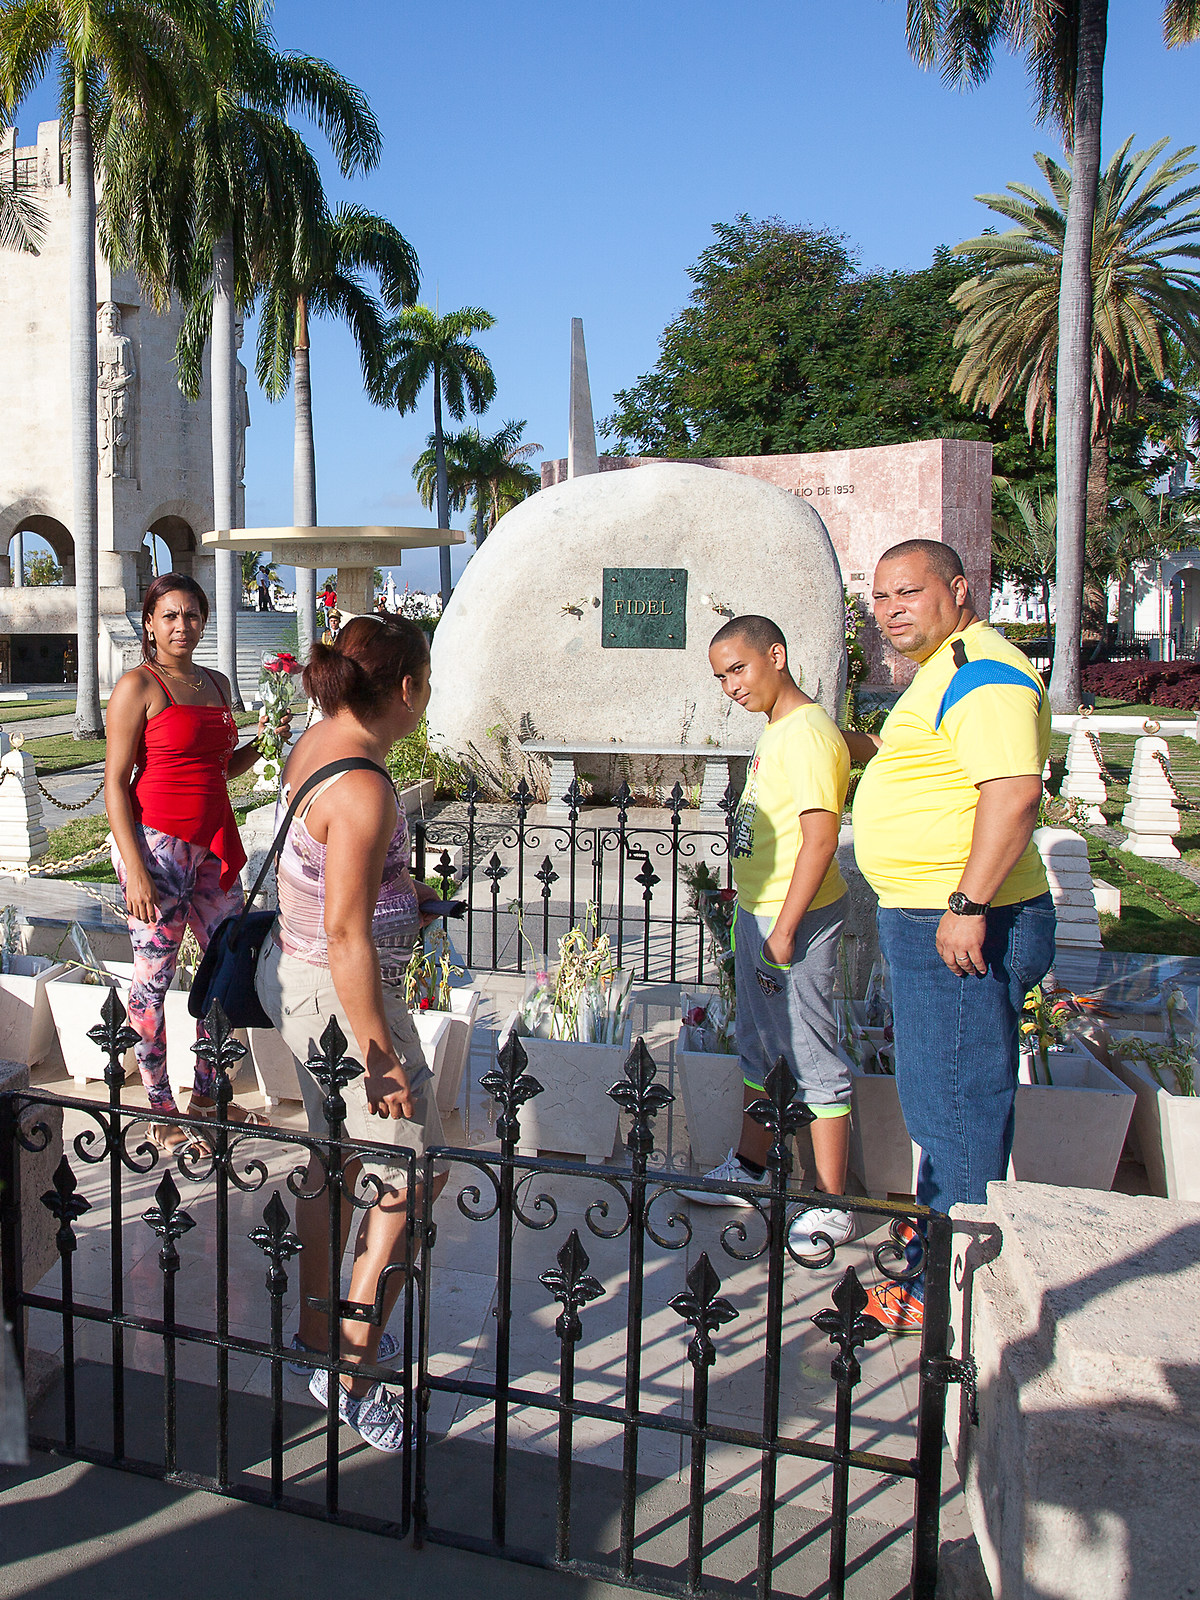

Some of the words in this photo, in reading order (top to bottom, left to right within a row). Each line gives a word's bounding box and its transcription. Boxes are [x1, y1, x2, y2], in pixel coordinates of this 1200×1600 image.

[817, 486, 831, 496] DE
[834, 484, 855, 495] 1953
[614, 599, 672, 616] FIDEL
